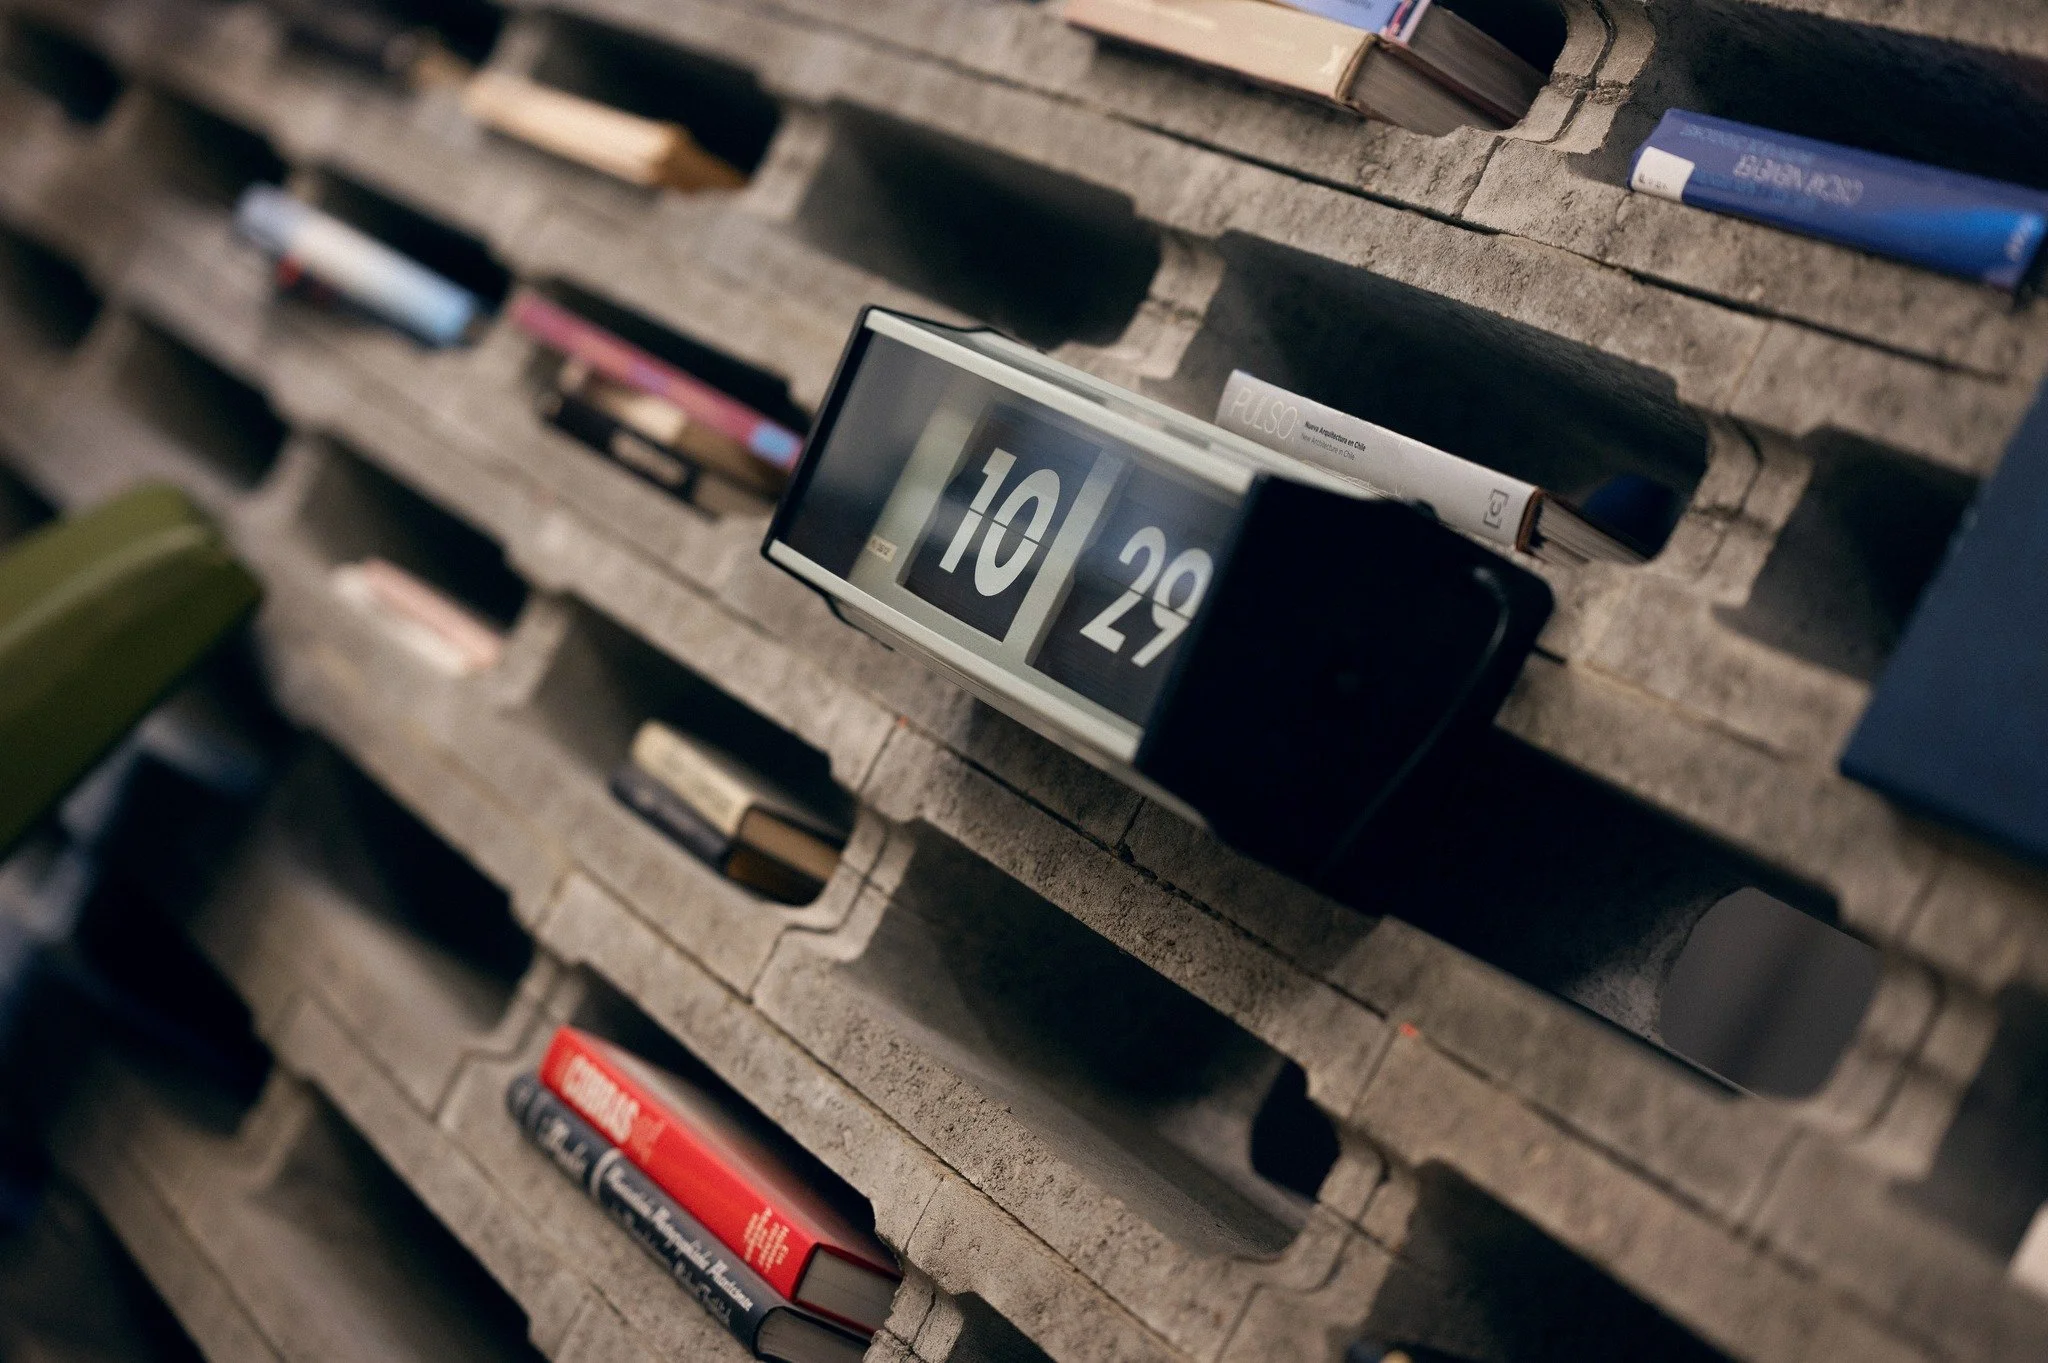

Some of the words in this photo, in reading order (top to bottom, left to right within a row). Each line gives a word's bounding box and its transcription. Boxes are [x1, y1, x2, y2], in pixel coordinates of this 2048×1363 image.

[1301, 432, 1312, 442] New
[1311, 437, 1339, 454] Architecture
[1343, 450, 1356, 461] Chile
[1304, 421, 1320, 433] Nueva
[1319, 427, 1348, 445] Arquitectura
[1347, 439, 1355, 448] en
[1354, 441, 1367, 452] Chile
[939, 447, 1060, 597] 10
[1079, 525, 1214, 668] 29
